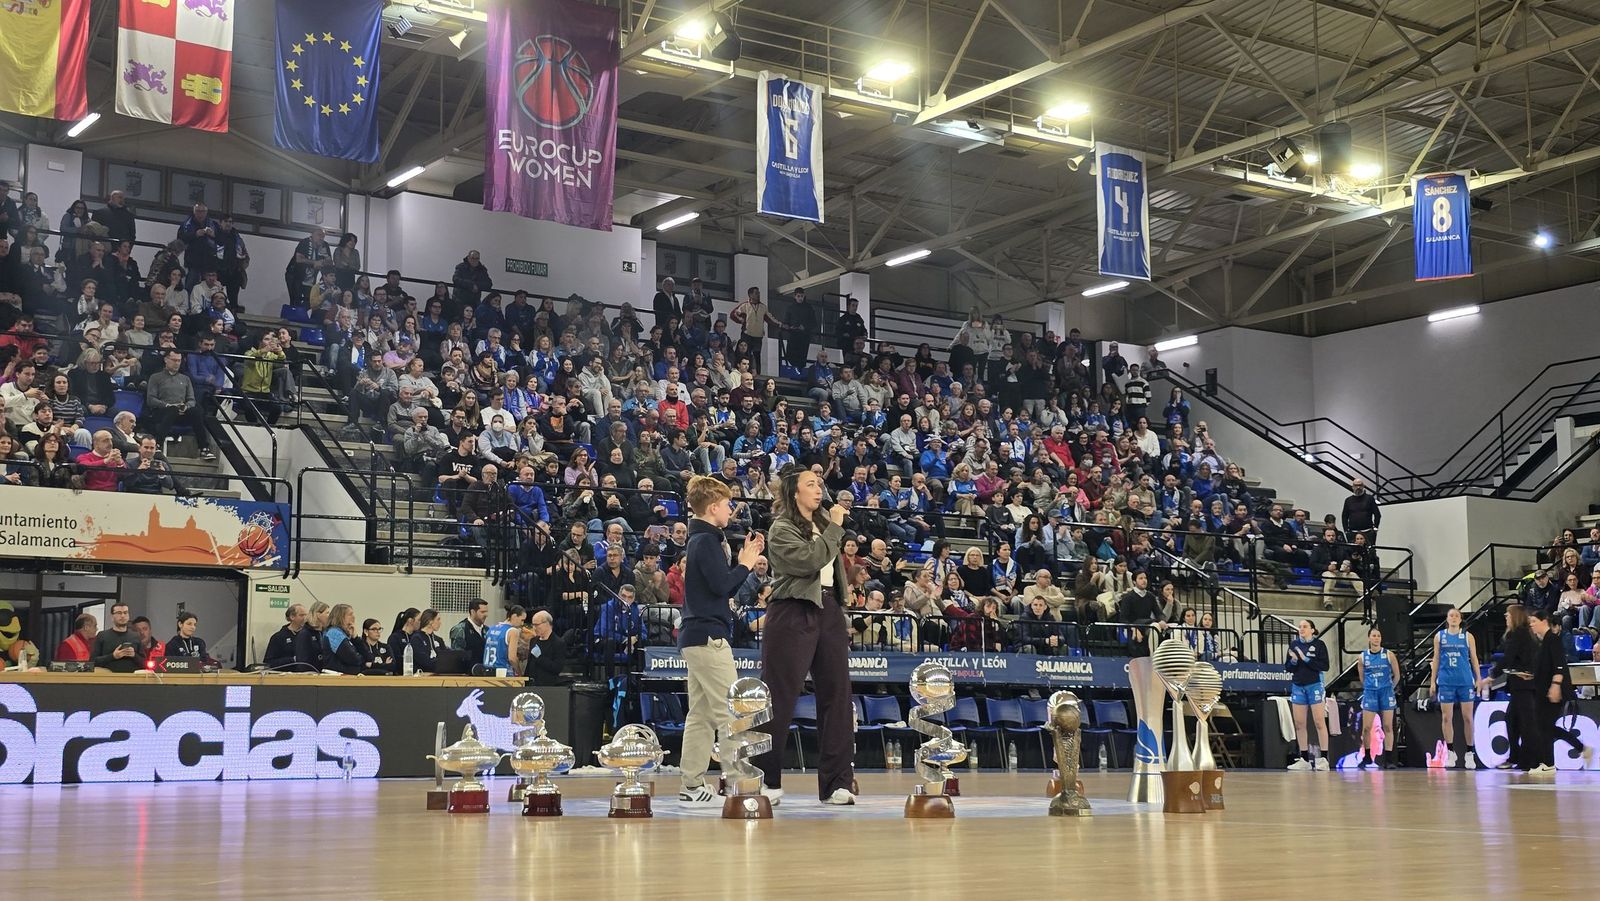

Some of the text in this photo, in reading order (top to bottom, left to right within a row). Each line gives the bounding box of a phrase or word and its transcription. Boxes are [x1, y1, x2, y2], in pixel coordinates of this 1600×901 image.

[498, 129, 603, 169] EUROCUP
[507, 151, 592, 190] WOMEN
[1114, 185, 1130, 224] 4
[1432, 196, 1453, 233] 8
[0, 530, 76, 548] Salamanca
[267, 585, 288, 593] SALIDA
[166, 661, 189, 669] POSSE
[484, 646, 497, 667] 13
[924, 655, 1007, 669] CASTILLA Y LEÓN
[1449, 657, 1458, 667] 12
[1035, 660, 1093, 674] SALAMANCA
